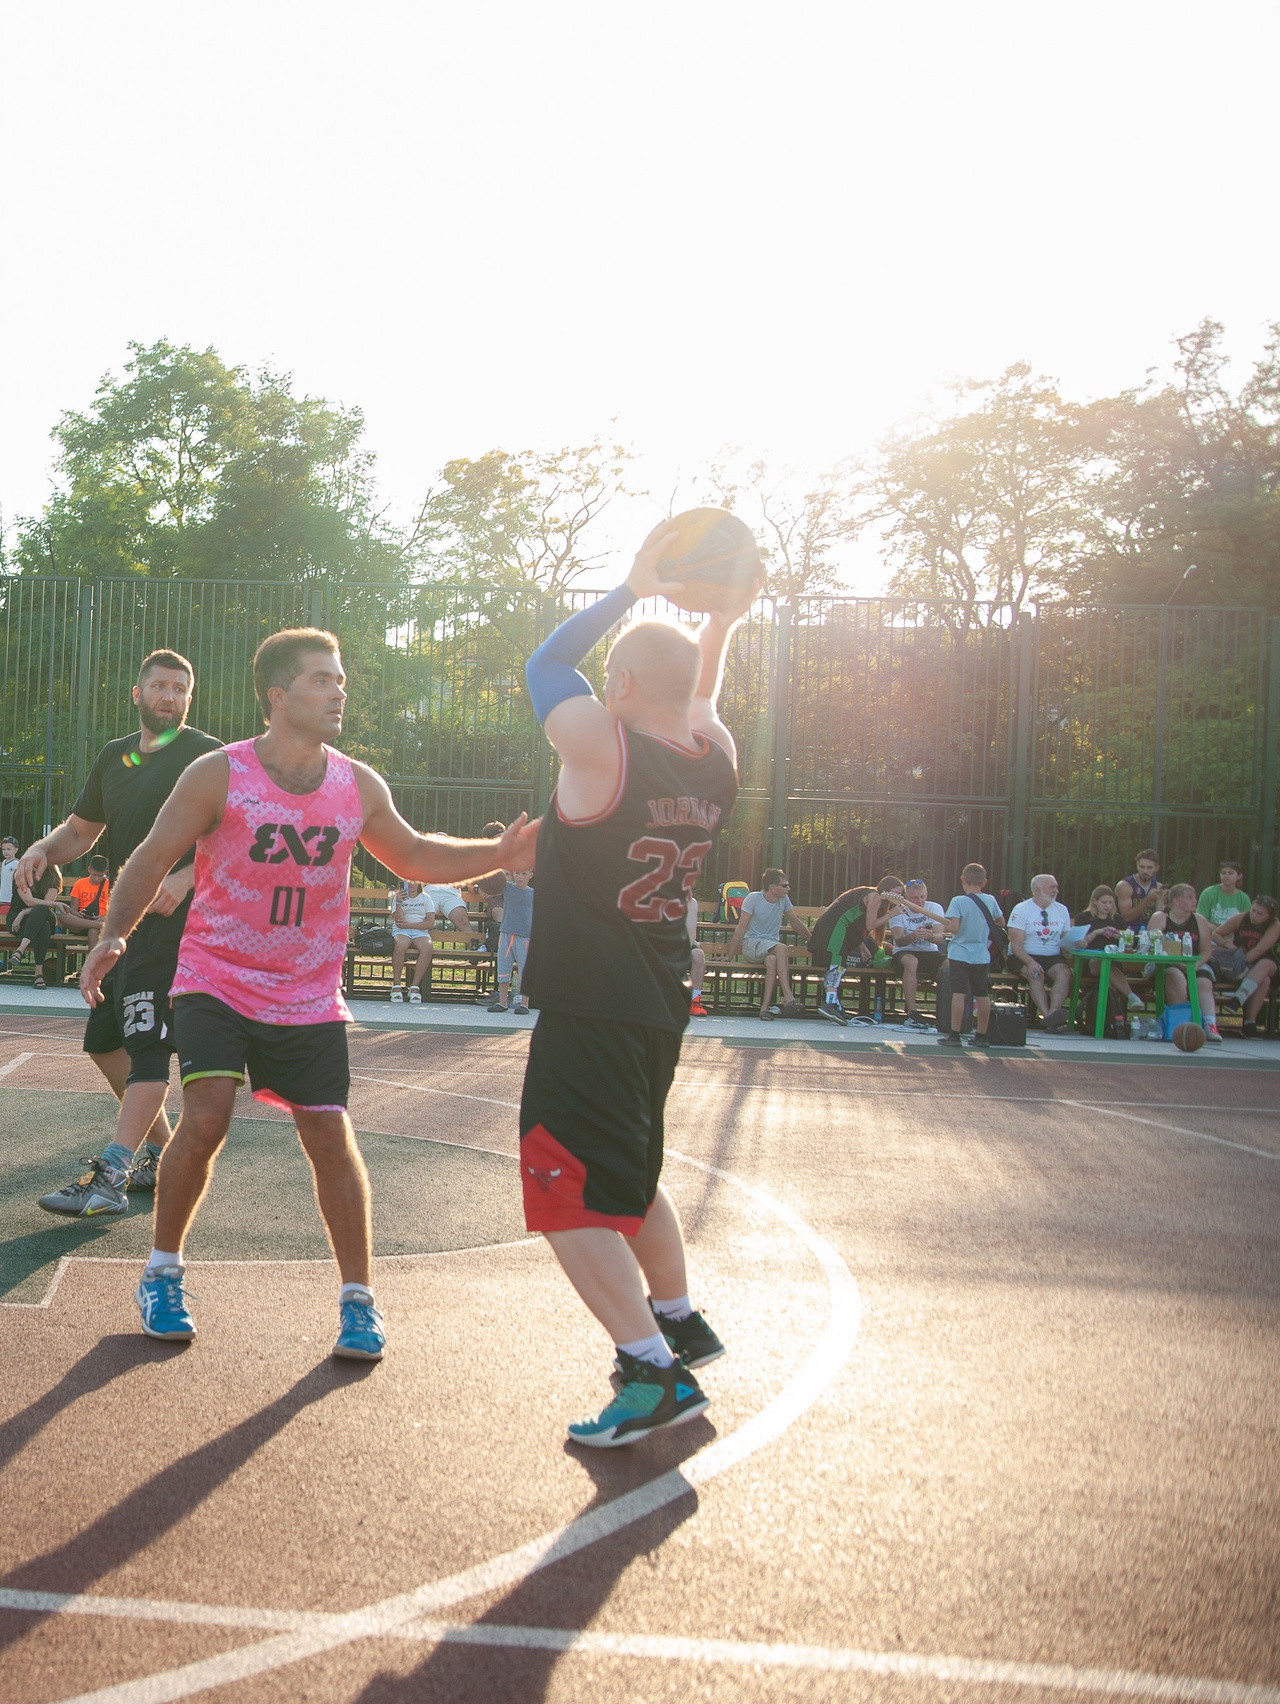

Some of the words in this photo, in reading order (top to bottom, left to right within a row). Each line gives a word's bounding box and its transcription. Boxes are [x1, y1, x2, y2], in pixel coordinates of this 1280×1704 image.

[645, 796, 721, 832] JORDAN
[617, 836, 712, 922] 23
[269, 886, 306, 927] 01
[122, 991, 154, 1006] JORDAN
[123, 1001, 155, 1038] 23
